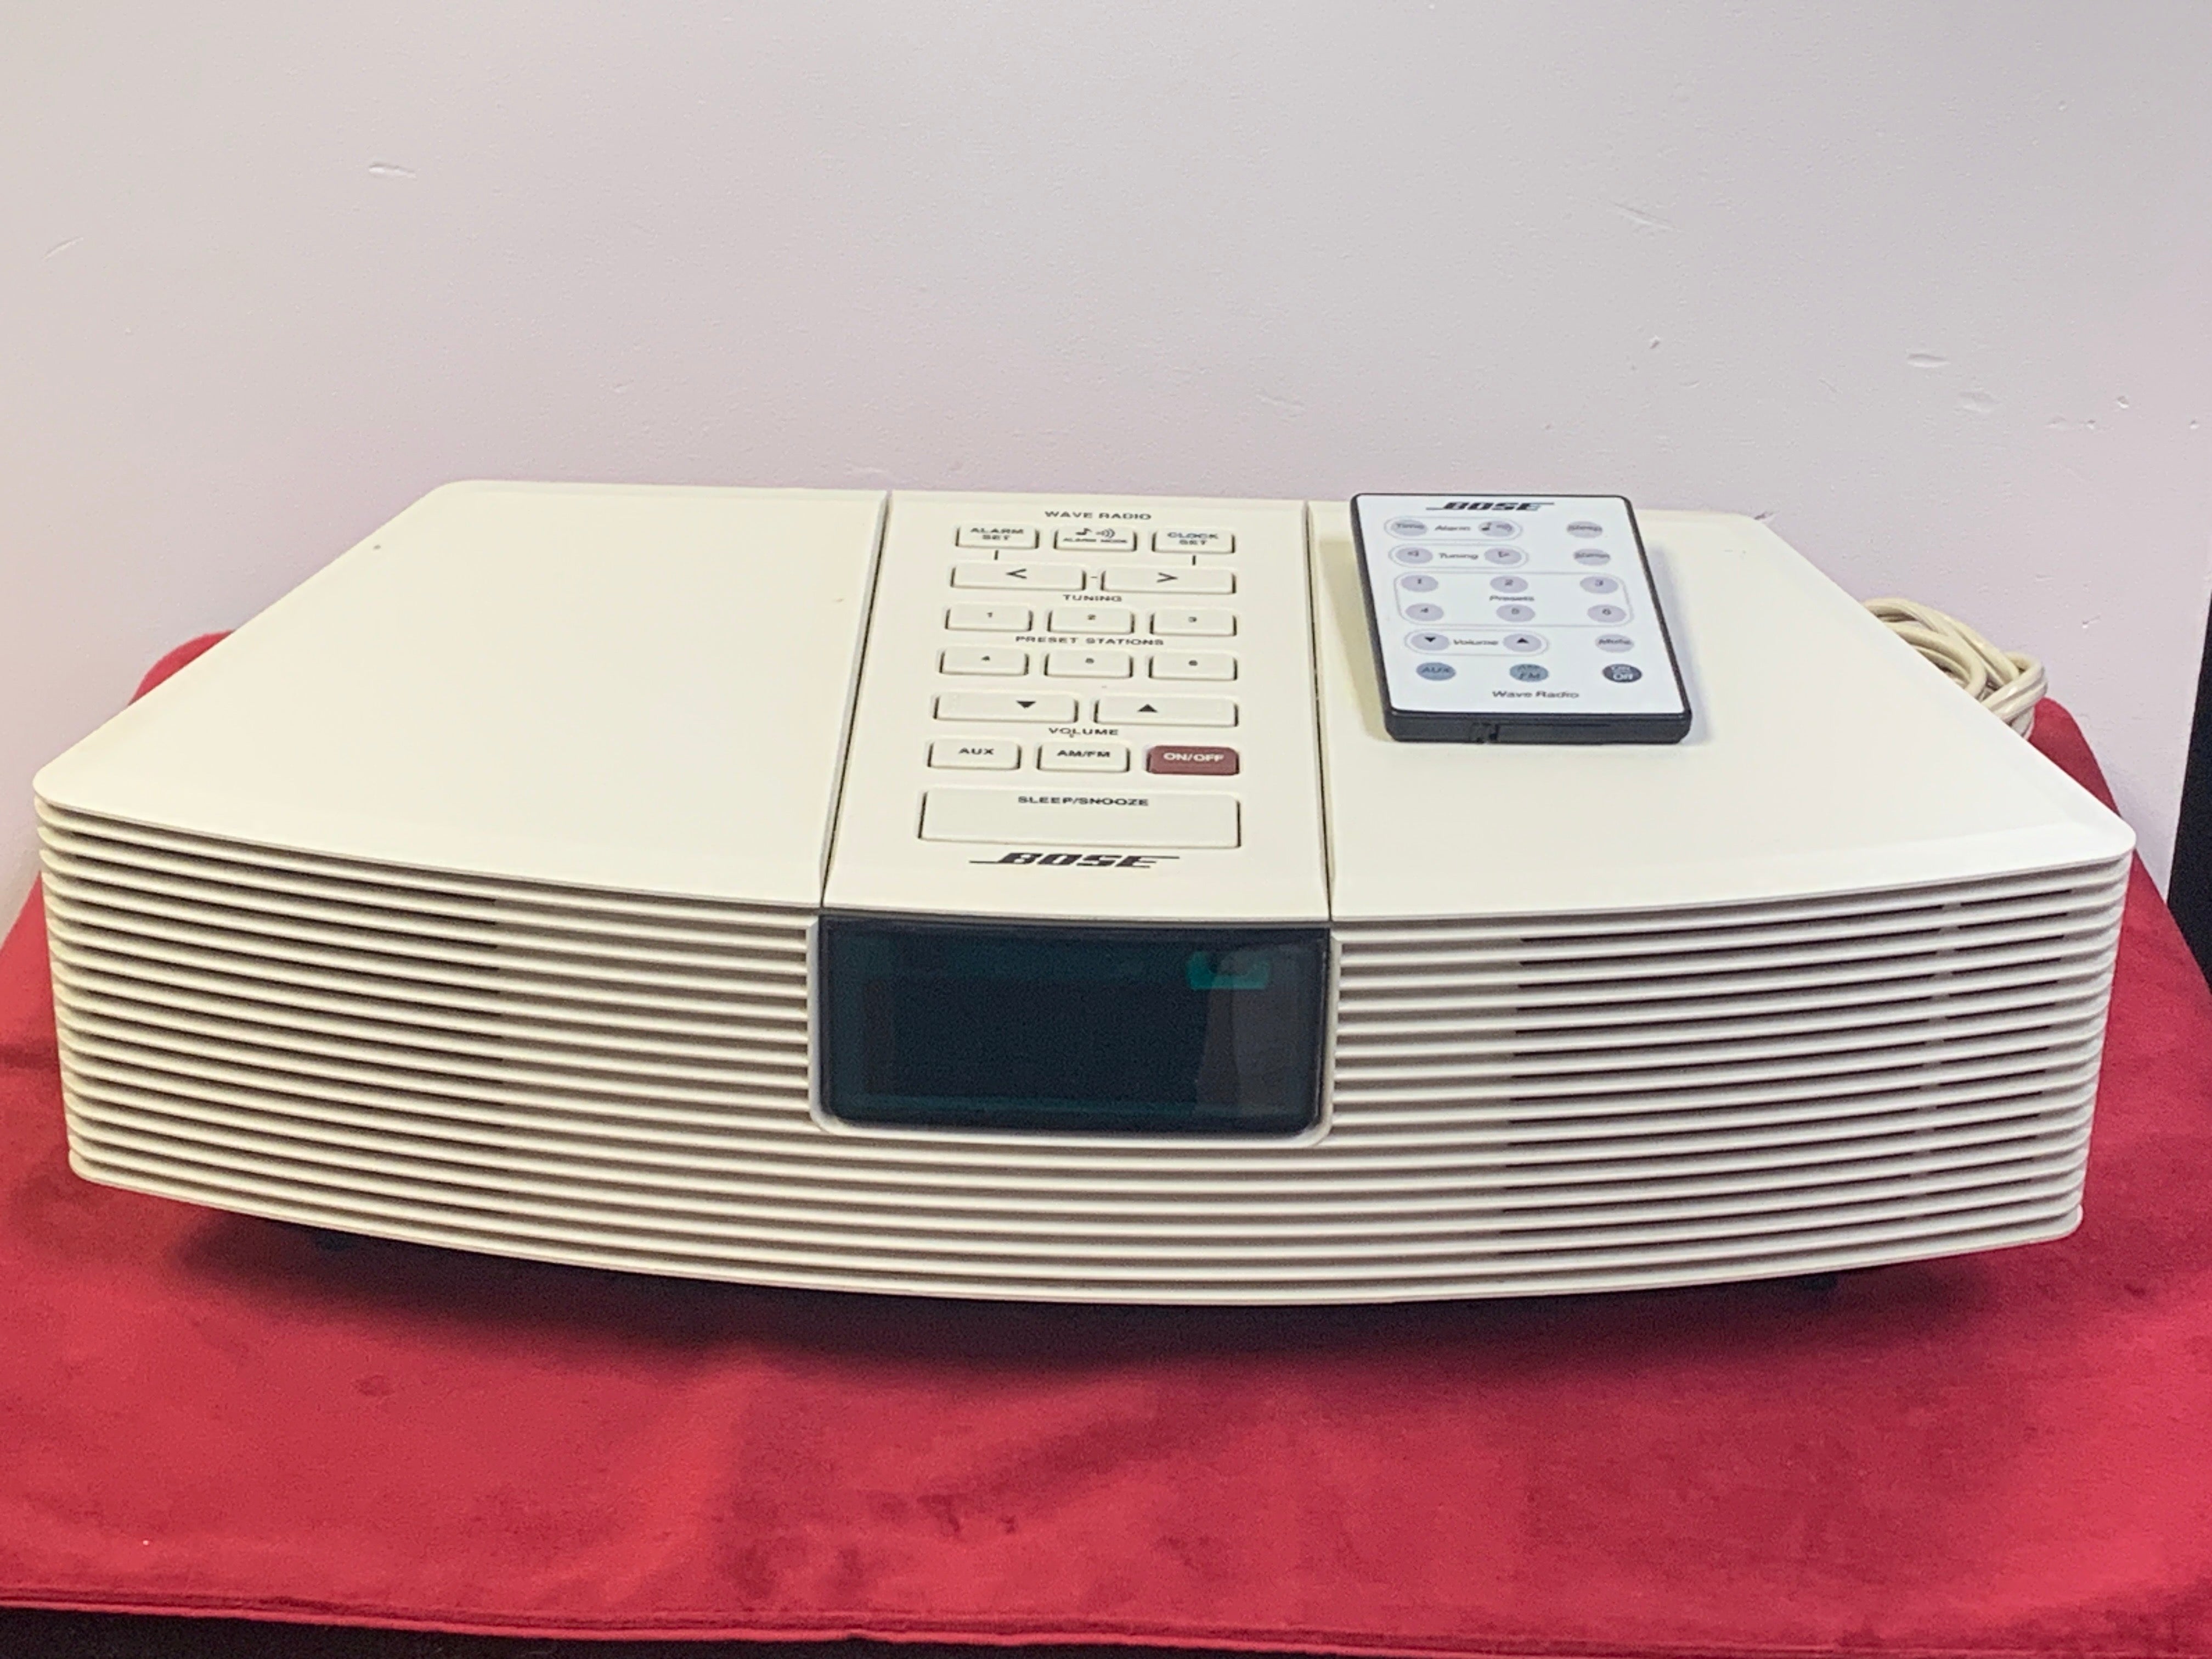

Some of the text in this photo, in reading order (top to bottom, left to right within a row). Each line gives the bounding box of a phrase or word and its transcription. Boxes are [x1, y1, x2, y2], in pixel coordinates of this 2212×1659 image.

[1426, 501, 1554, 511] BOSE
[1167, 532, 1218, 540] CLOCK
[1438, 552, 1479, 561] Tuning
[1063, 594, 1122, 602] TUNING
[1015, 636, 1164, 646] PRESET STATIONS
[1535, 690, 1579, 699] Radio
[1048, 727, 1119, 737] VOLUME
[1057, 749, 1110, 758] AM/FM
[1163, 752, 1224, 762] ON/OFF
[1018, 796, 1148, 806] SLEEP/SNOOZE
[969, 852, 1180, 868] BOSE
